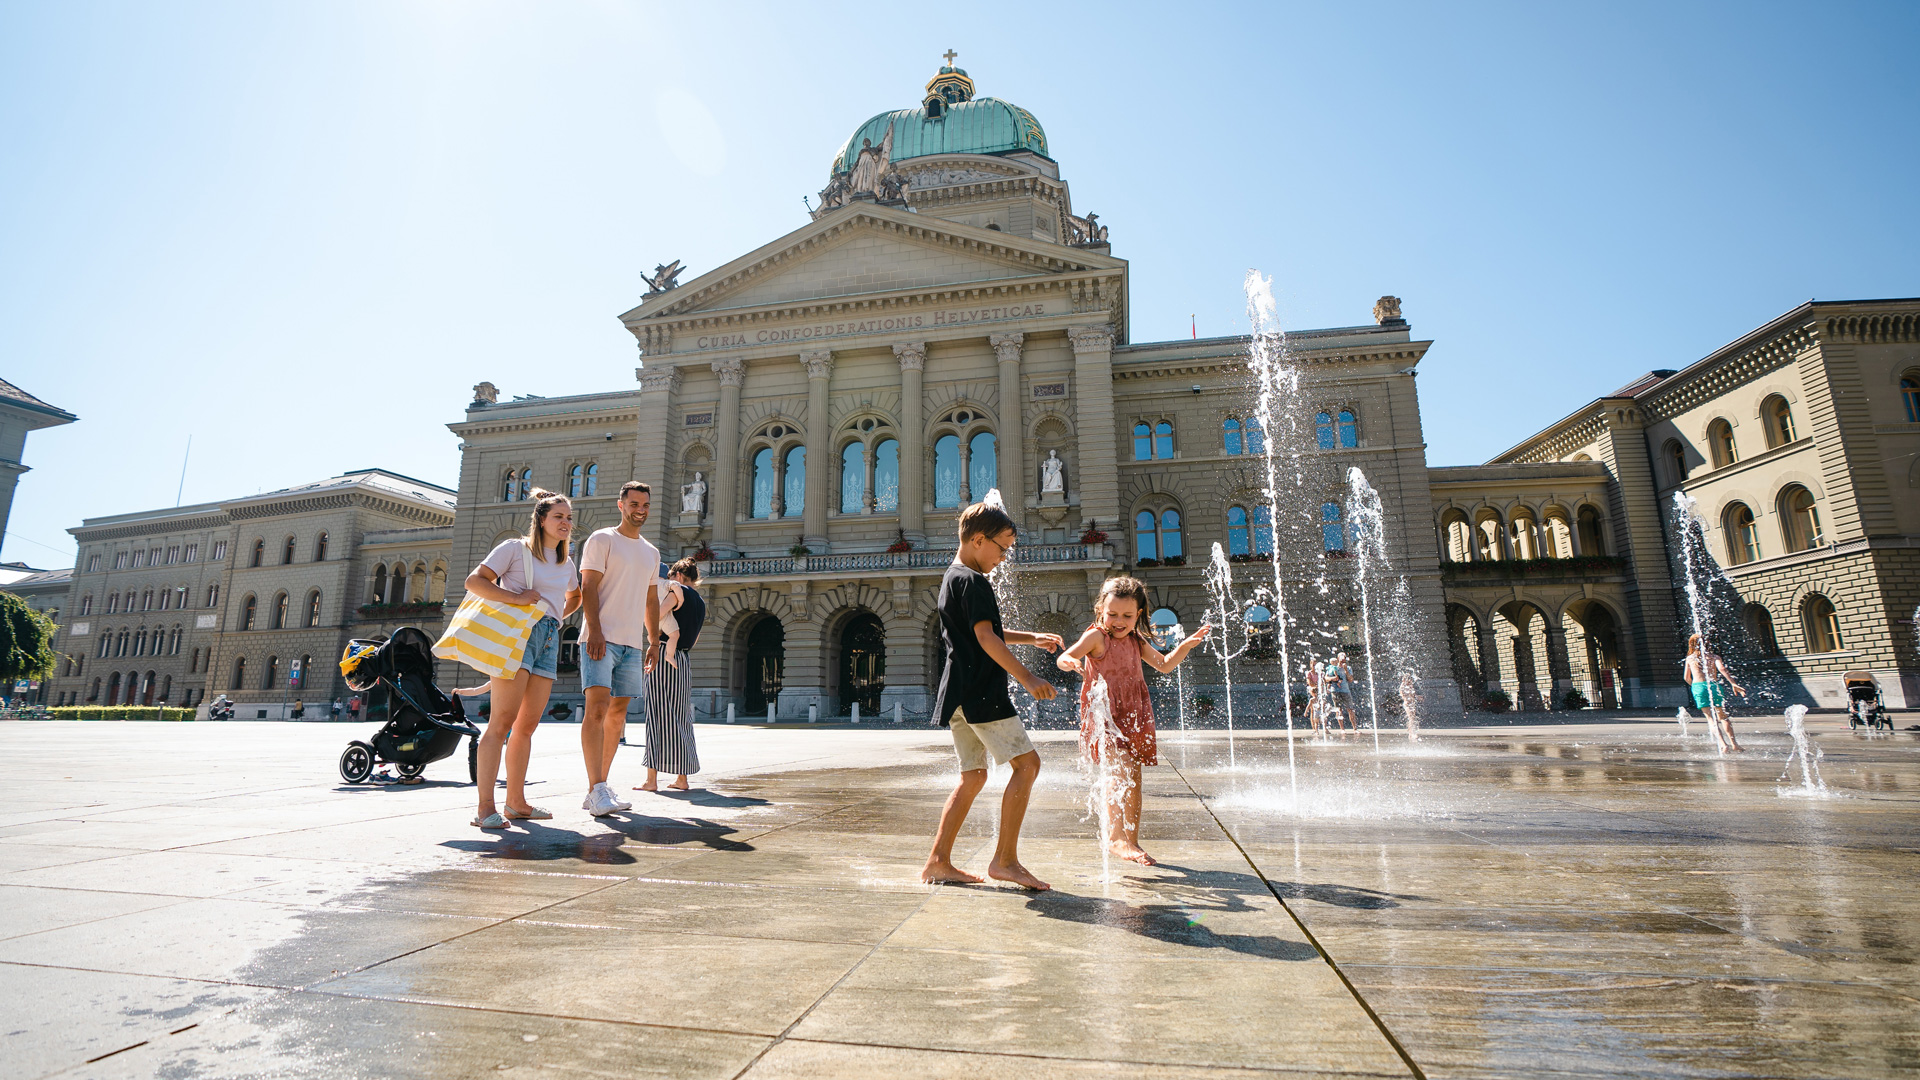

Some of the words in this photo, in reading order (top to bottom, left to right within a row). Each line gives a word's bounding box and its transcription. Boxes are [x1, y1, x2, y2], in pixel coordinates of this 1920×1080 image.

[697, 334, 747, 349] CURIA
[756, 316, 923, 342] CONFOEDERATIONIS
[934, 304, 1044, 324] HELVETICAE
